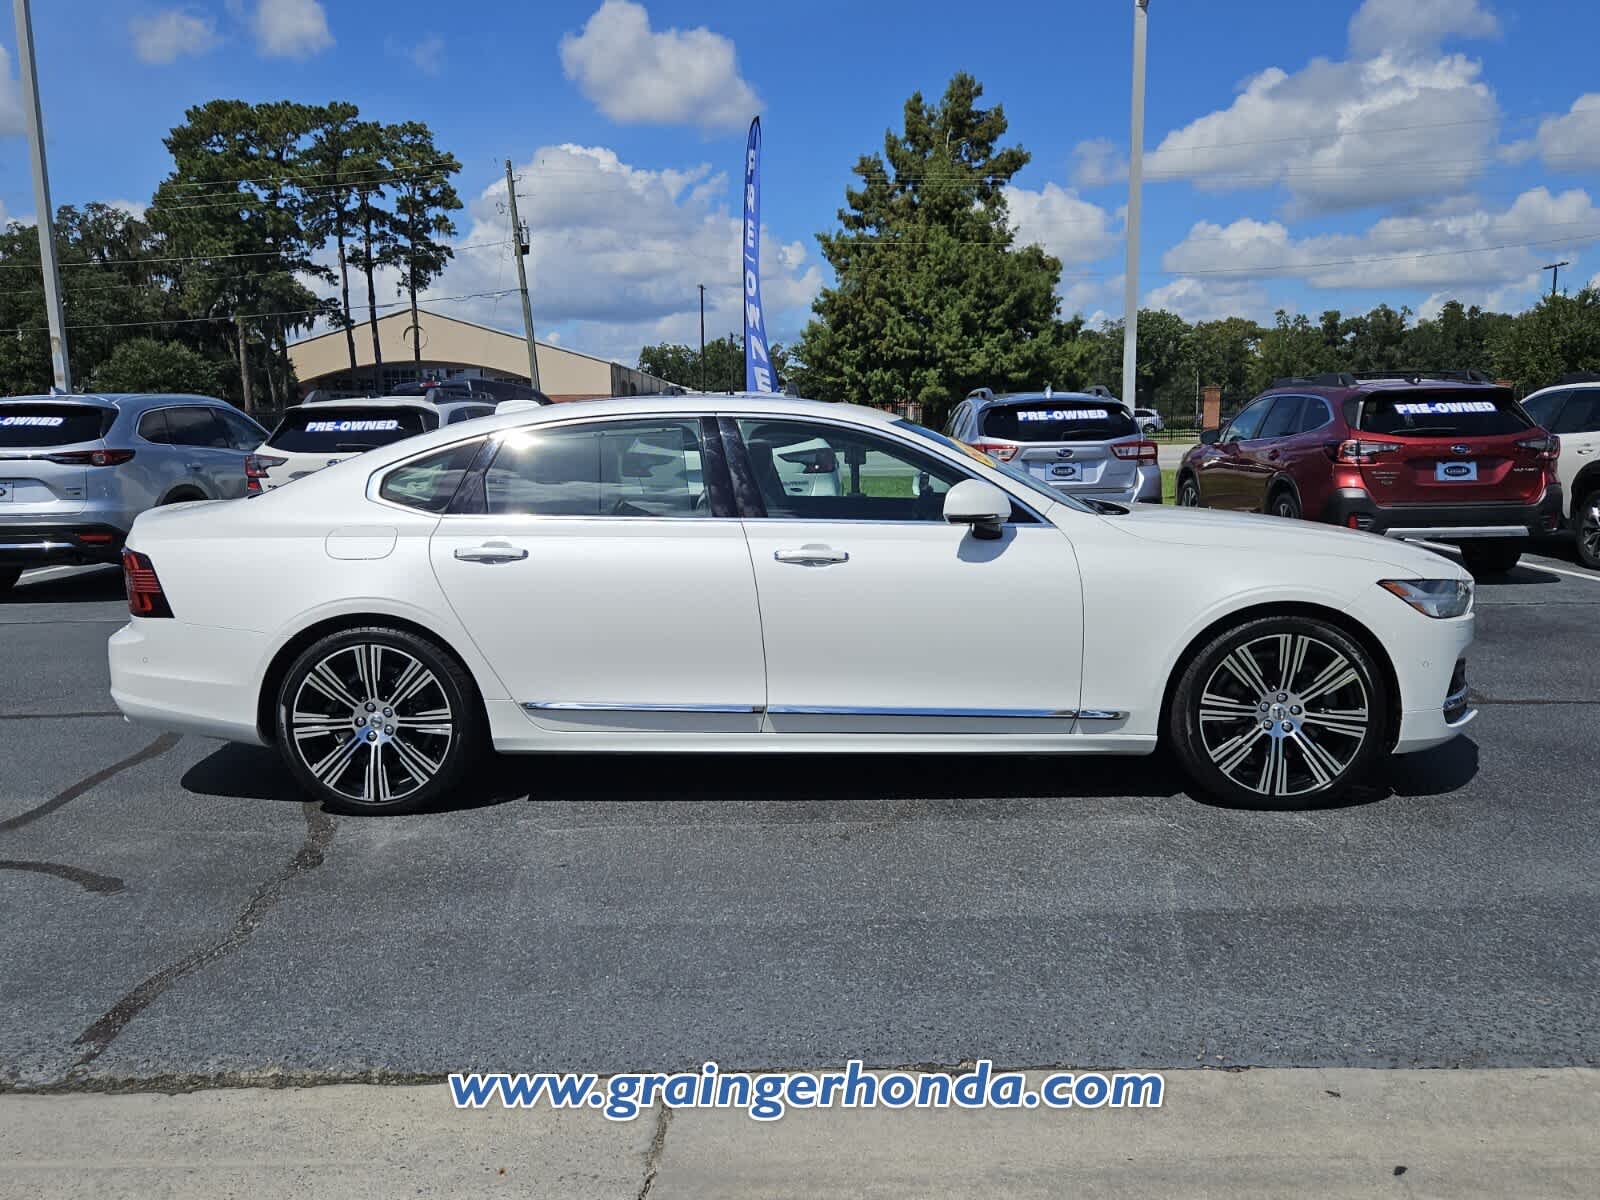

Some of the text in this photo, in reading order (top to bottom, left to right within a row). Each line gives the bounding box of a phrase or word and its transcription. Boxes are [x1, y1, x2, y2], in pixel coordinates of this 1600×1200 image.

[1017, 409, 1109, 421] PRE-OWNED
[1394, 401, 1497, 415] PRE-OWNED
[305, 419, 398, 433] PRE-OWNED
